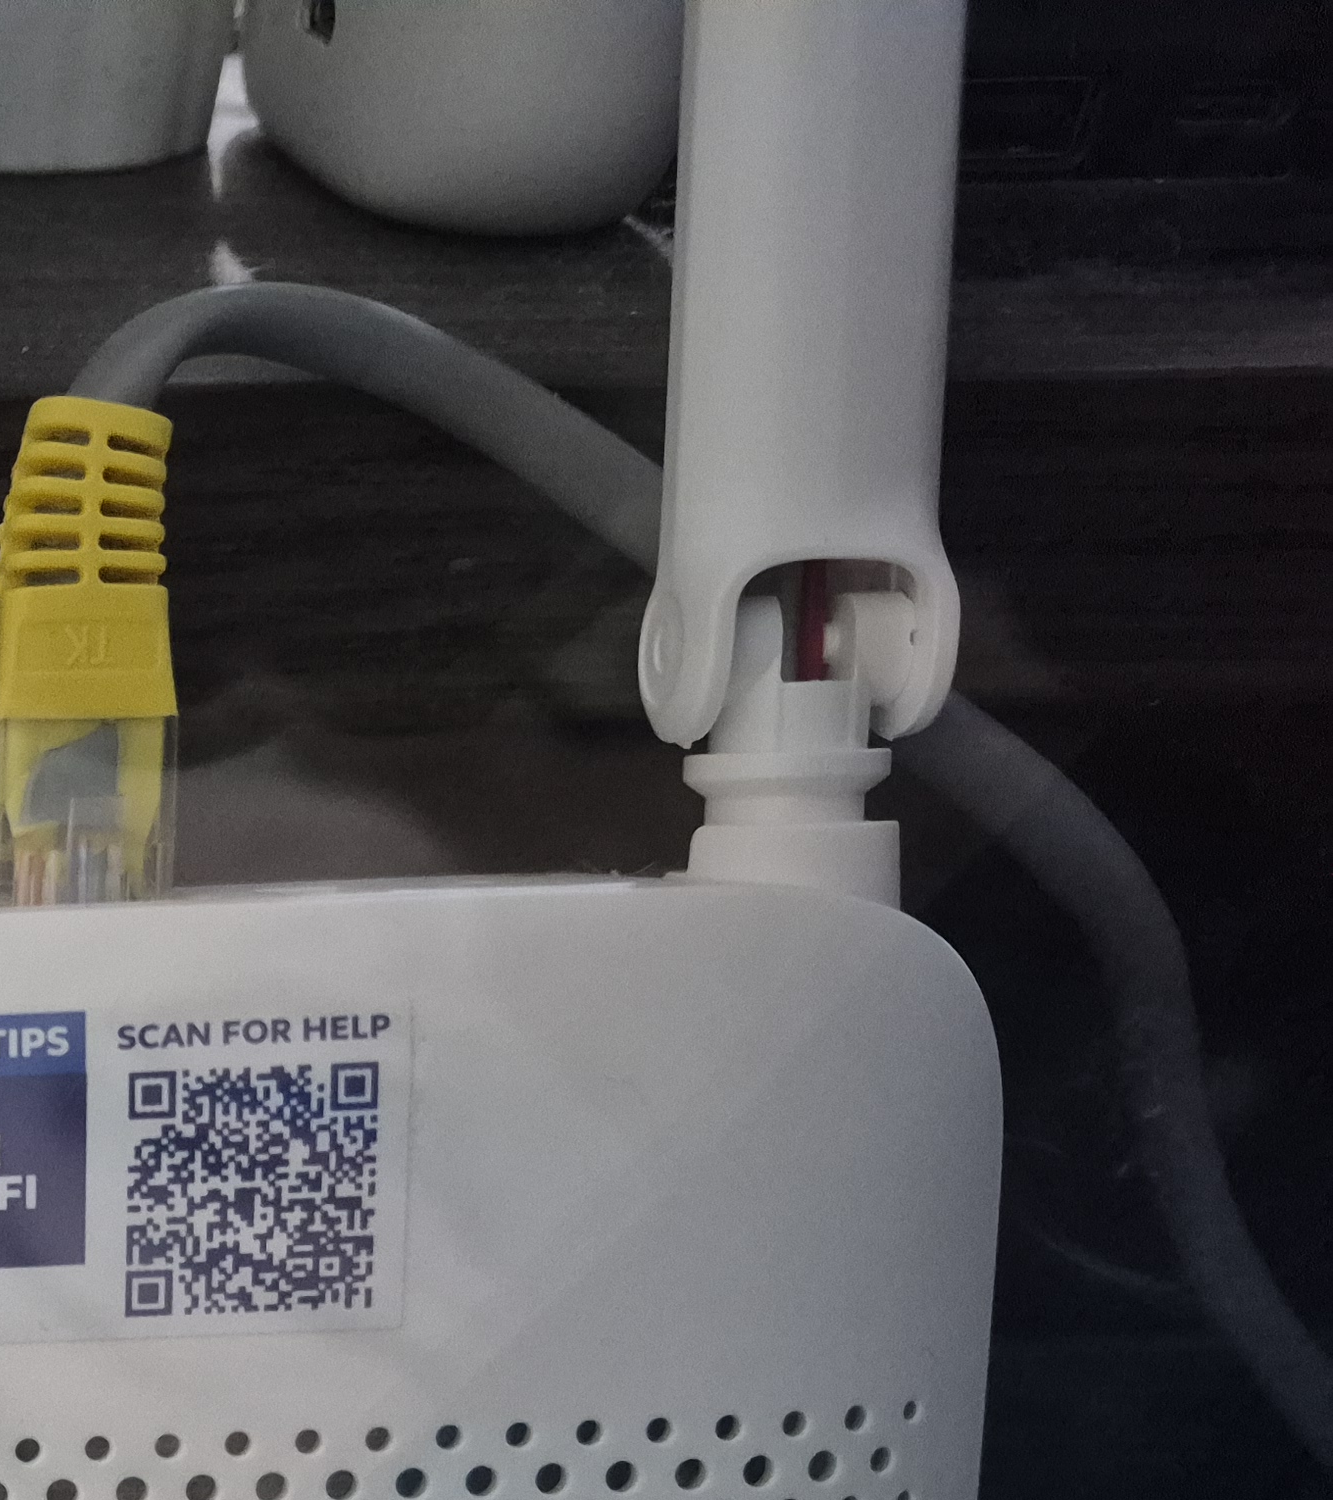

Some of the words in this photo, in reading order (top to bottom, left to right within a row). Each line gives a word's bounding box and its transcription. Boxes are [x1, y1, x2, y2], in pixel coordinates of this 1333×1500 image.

[117, 1021, 211, 1051] SCAN
[222, 1017, 292, 1045] FOR
[303, 1013, 391, 1042] HELP
